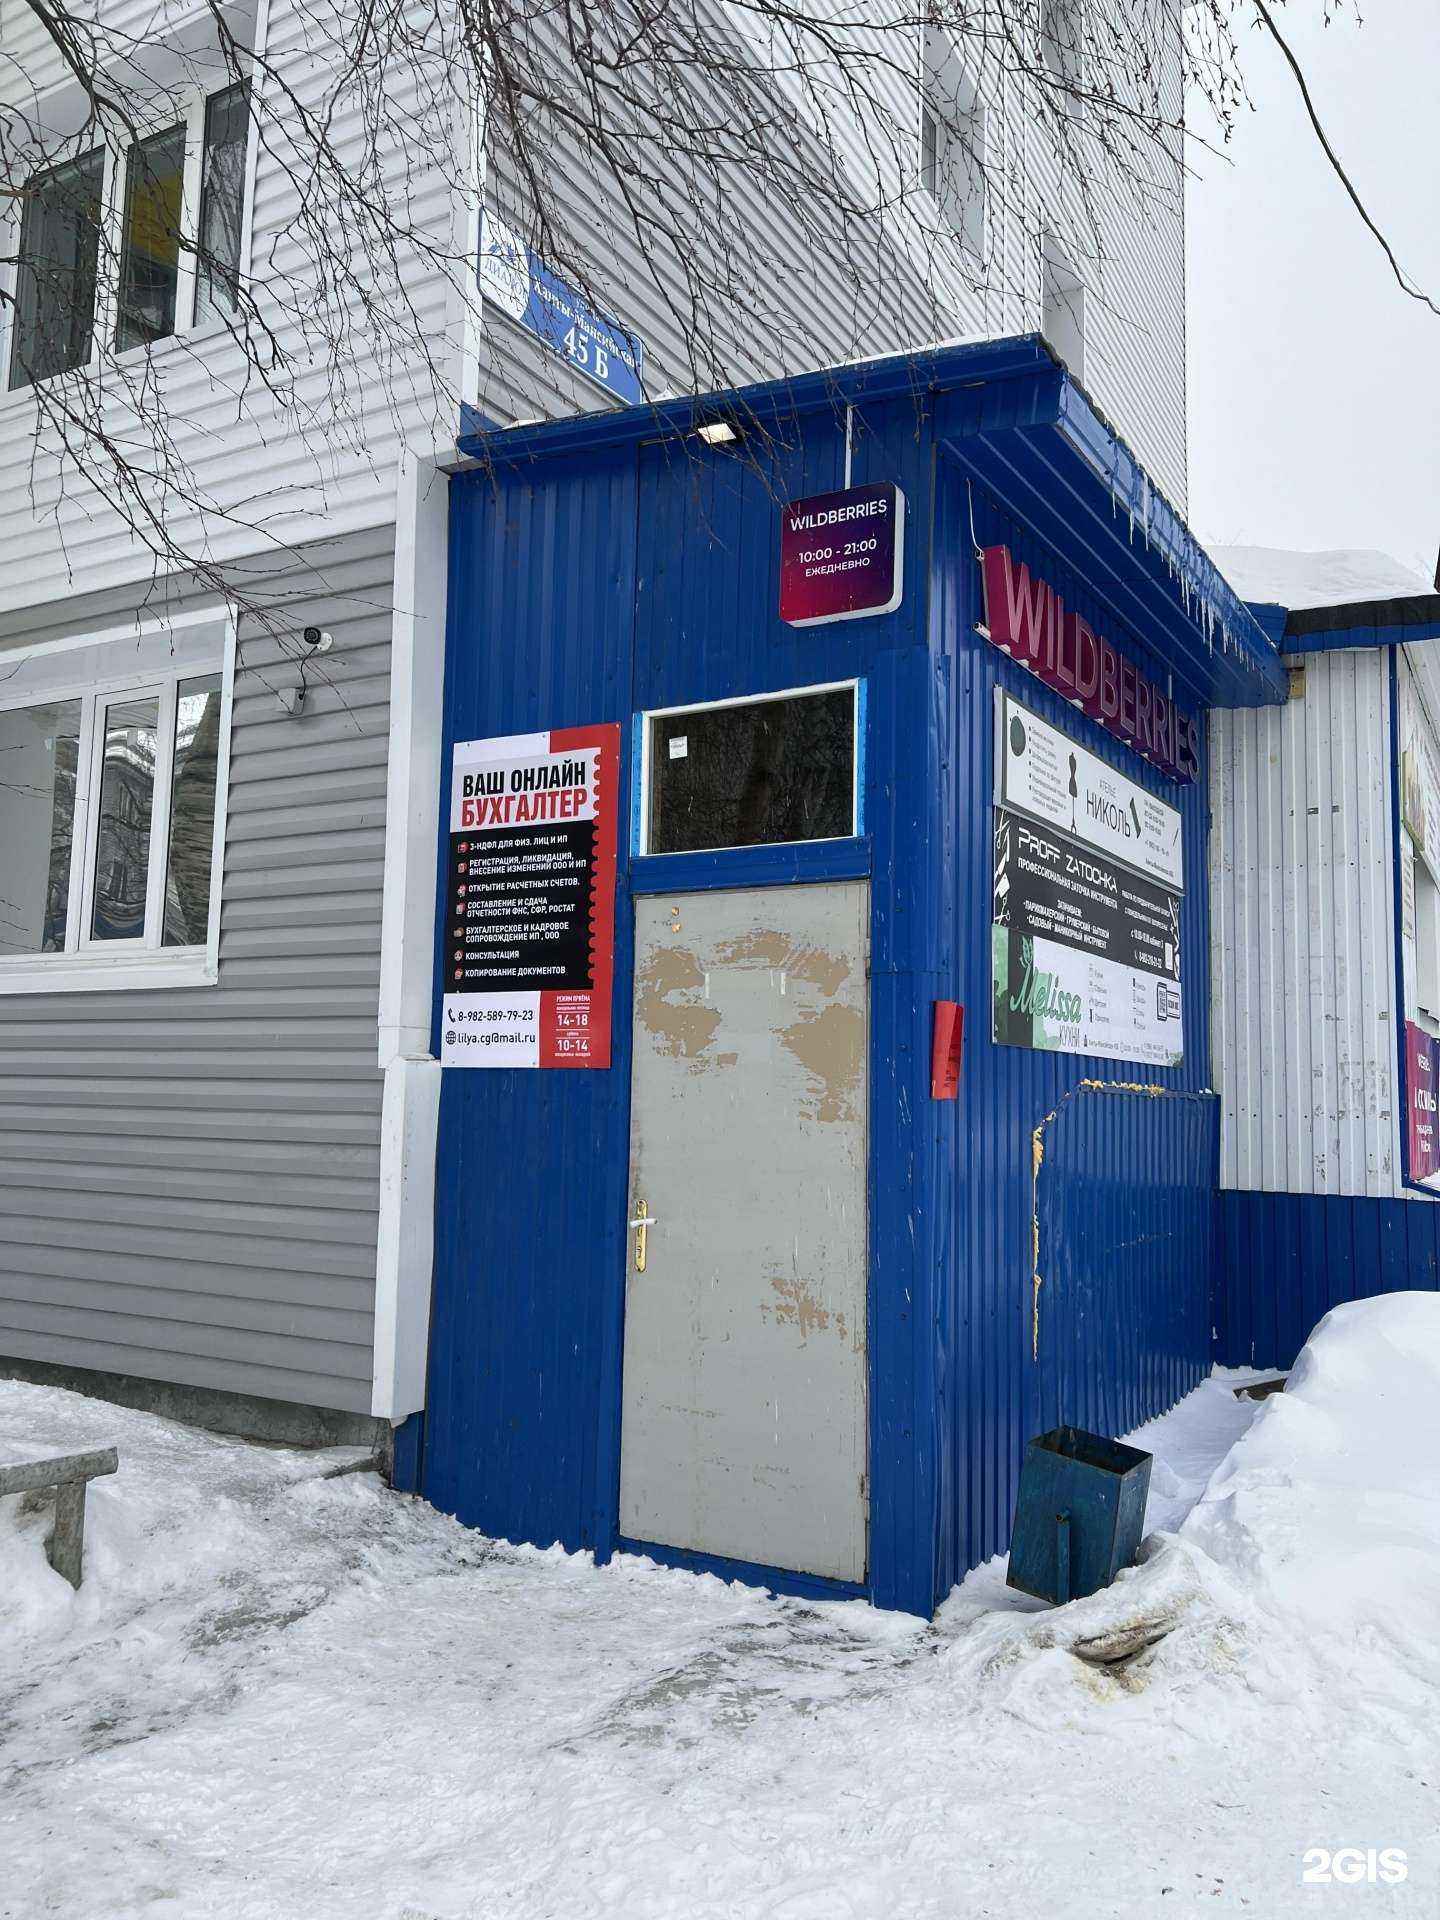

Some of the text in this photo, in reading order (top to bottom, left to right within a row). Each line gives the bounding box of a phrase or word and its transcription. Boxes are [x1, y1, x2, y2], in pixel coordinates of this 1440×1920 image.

[563, 327, 609, 379] 45 Б
[790, 499, 887, 531] WILDBERRIES
[799, 548, 833, 563] 10:00
[844, 538, 877, 555] 21:00
[805, 557, 871, 577] ЕЖЕДНЕВНО
[985, 545, 1201, 783] WILDBERRIES
[463, 759, 586, 797] ВАШ ОНЛАЙН
[462, 788, 587, 827] БУХГАЛТЕР
[1086, 788, 1131, 838] НИКОЛЬ
[470, 834, 568, 851] 3-НДФЛ ДЛЯ ФИЗ. ЛИЦ И ИП
[469, 851, 574, 867] РЕГИСТРАЦИЯ, ЛИКВИДАЦИЯ,
[469, 865, 506, 876] ВНЕСЕНИЕ
[553, 861, 567, 870] ООО
[576, 859, 587, 868] ИП
[1018, 826, 1060, 863] PROFF
[1065, 854, 1118, 893] ZATOCHKA
[1018, 857, 1071, 890] ПРОФЕССИОНАЛЬНАЯ
[468, 877, 580, 893] ОТКРЫТИЕ РАСЧЕТНЫХ СЧЕТОВ.
[467, 896, 548, 909] СОСТАВЛЕНИЕ И СДАЧА
[467, 907, 511, 918] ОТЧЕТНОСТИ
[512, 906, 529, 916] ФНС,
[549, 903, 575, 913] РОСТАТ
[466, 921, 569, 935] БУХГАЛТЕРСКОЕ И КАДРОВОЕ
[466, 933, 528, 943] СОПРОВОЖДЕНИЕ
[529, 932, 540, 941] ИП
[545, 931, 559, 940] ООО
[465, 950, 520, 961] КОНСУЛЬТАЦИЯ
[465, 966, 566, 978] КОПИРОВАНИЕ ДОКУМЕНТОВ
[1010, 963, 1082, 1024] Melissa
[458, 1010, 534, 1022] 8-982-589-79-23
[557, 1013, 588, 1026] 14-18
[458, 1032, 536, 1046] lilya.cg@mail.ru
[557, 1039, 588, 1052] 10-14
